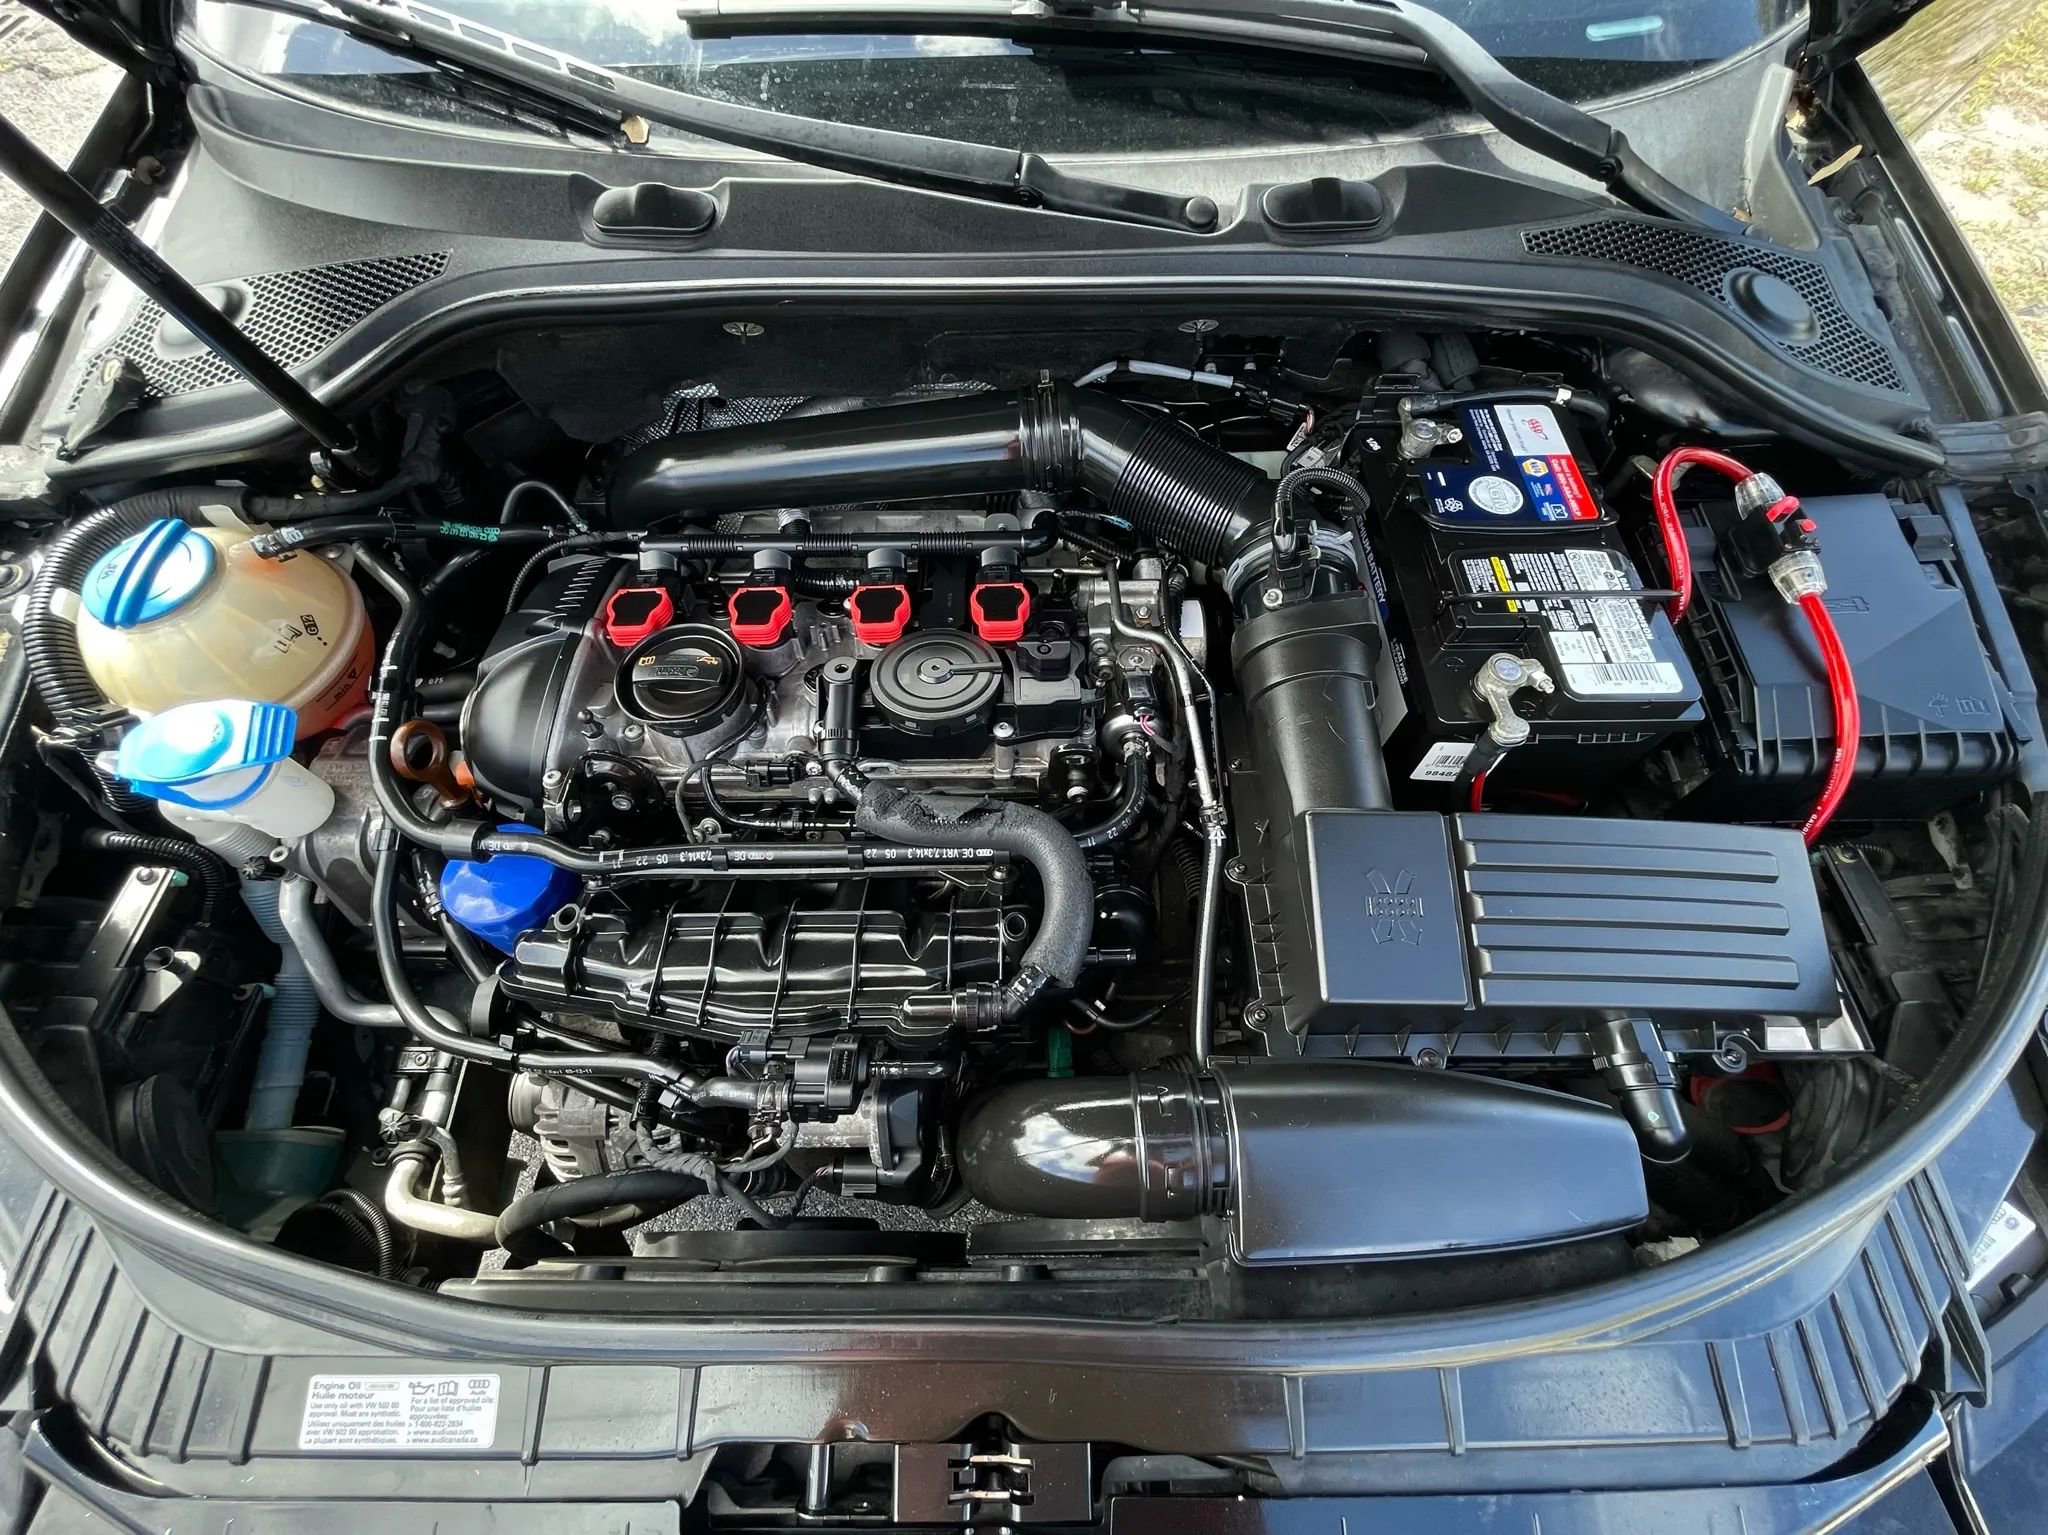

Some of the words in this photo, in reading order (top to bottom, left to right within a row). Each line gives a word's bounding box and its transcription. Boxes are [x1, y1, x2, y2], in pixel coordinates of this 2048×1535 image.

[1530, 462, 1542, 474] NAPA
[1486, 479, 1511, 512] AGM
[1356, 515, 1371, 552] EMIUM
[1367, 552, 1386, 604] BATTERY
[302, 614, 319, 634] G12
[1107, 826, 1118, 839] 22
[488, 840, 500, 850] DE
[734, 852, 746, 862] DE
[866, 849, 878, 859] 22
[886, 849, 896, 859] 05
[908, 848, 940, 860] 7,3x14,3
[942, 848, 959, 859] VRT
[962, 848, 974, 858] DE
[636, 856, 648, 866] 22
[656, 854, 668, 864] 05
[314, 1381, 345, 1391] Engine
[348, 1381, 362, 1390] Oil
